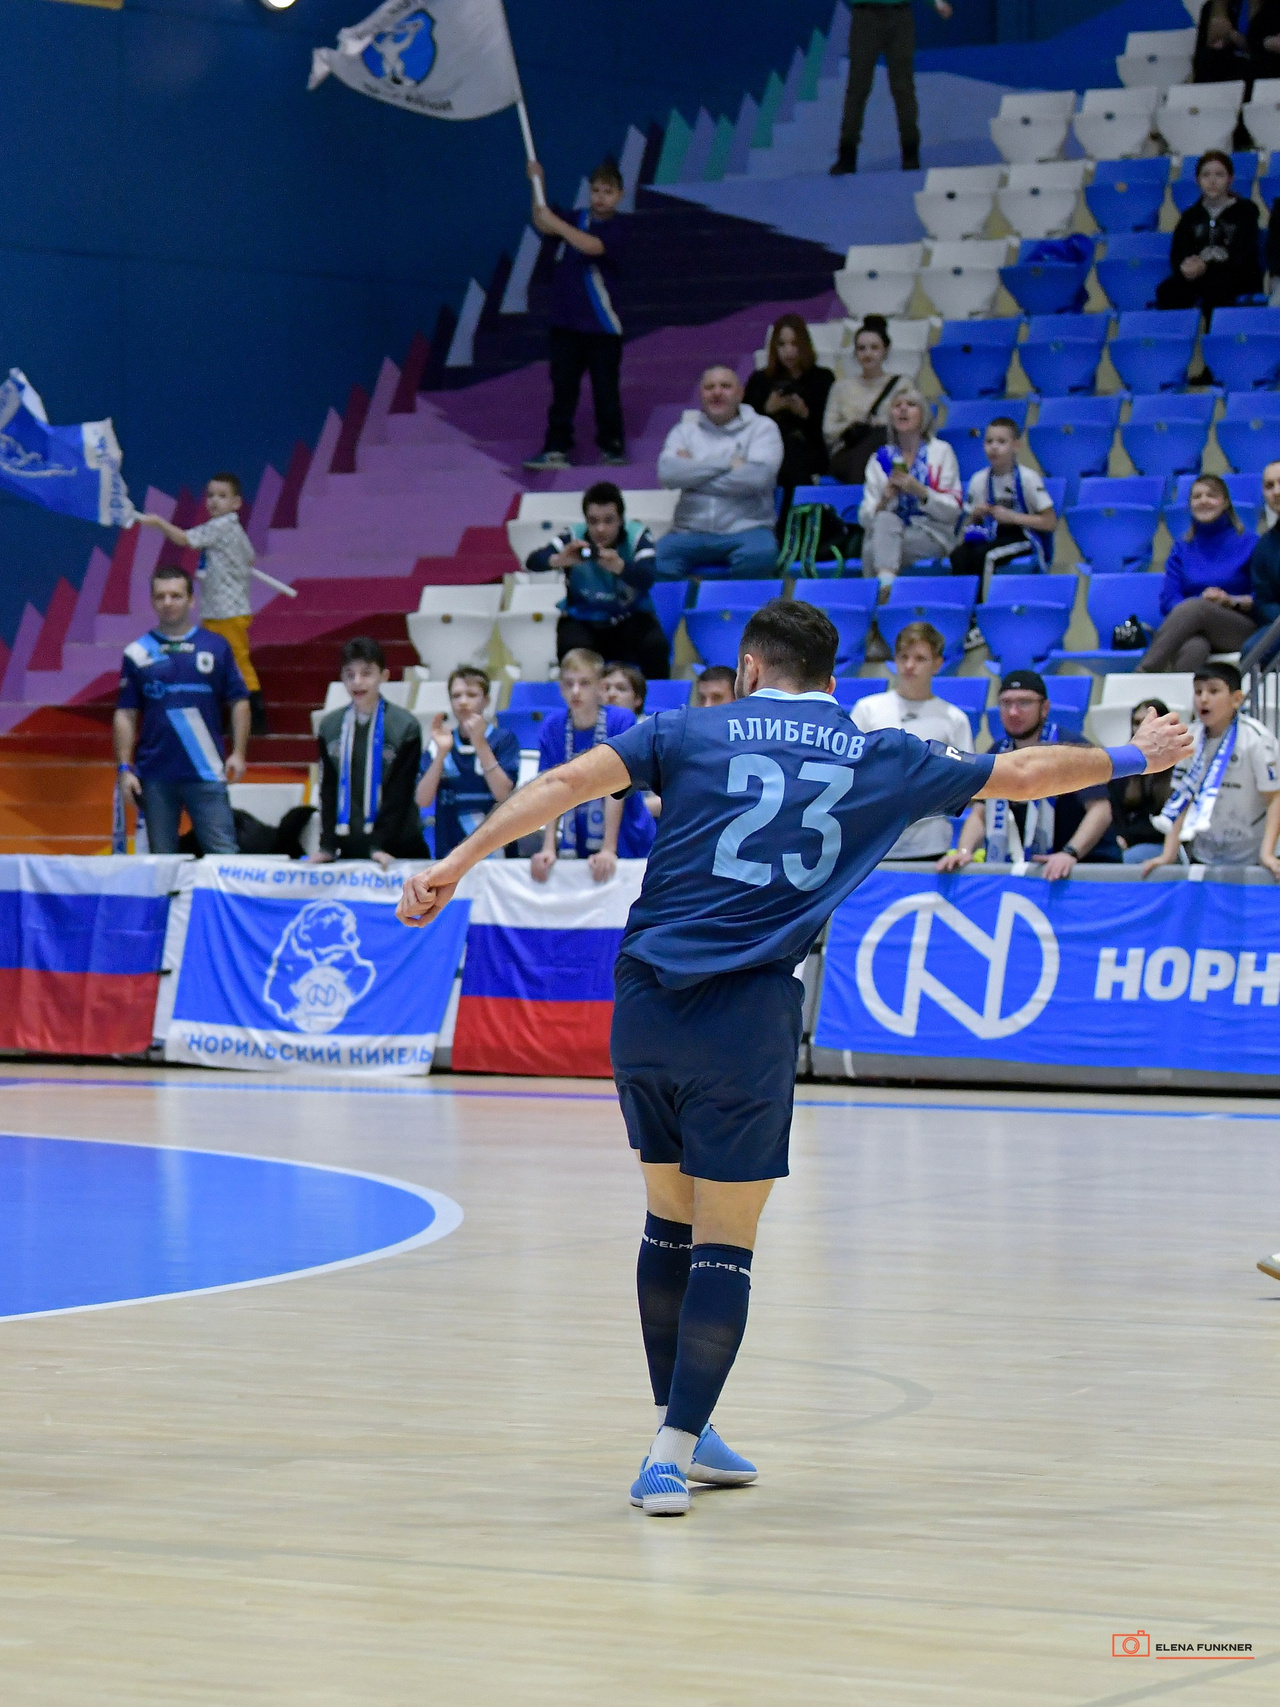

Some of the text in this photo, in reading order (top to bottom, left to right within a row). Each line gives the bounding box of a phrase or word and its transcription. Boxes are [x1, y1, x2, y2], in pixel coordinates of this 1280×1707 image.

[727, 717, 866, 760] АЛИБЕКОВ
[712, 753, 854, 892] 23
[272, 867, 403, 889] ФУТБОЛЬНЫЙ
[349, 1046, 433, 1065] НИКЕЛЬ
[649, 1238, 693, 1250] KELM
[691, 1260, 738, 1272] KELME
